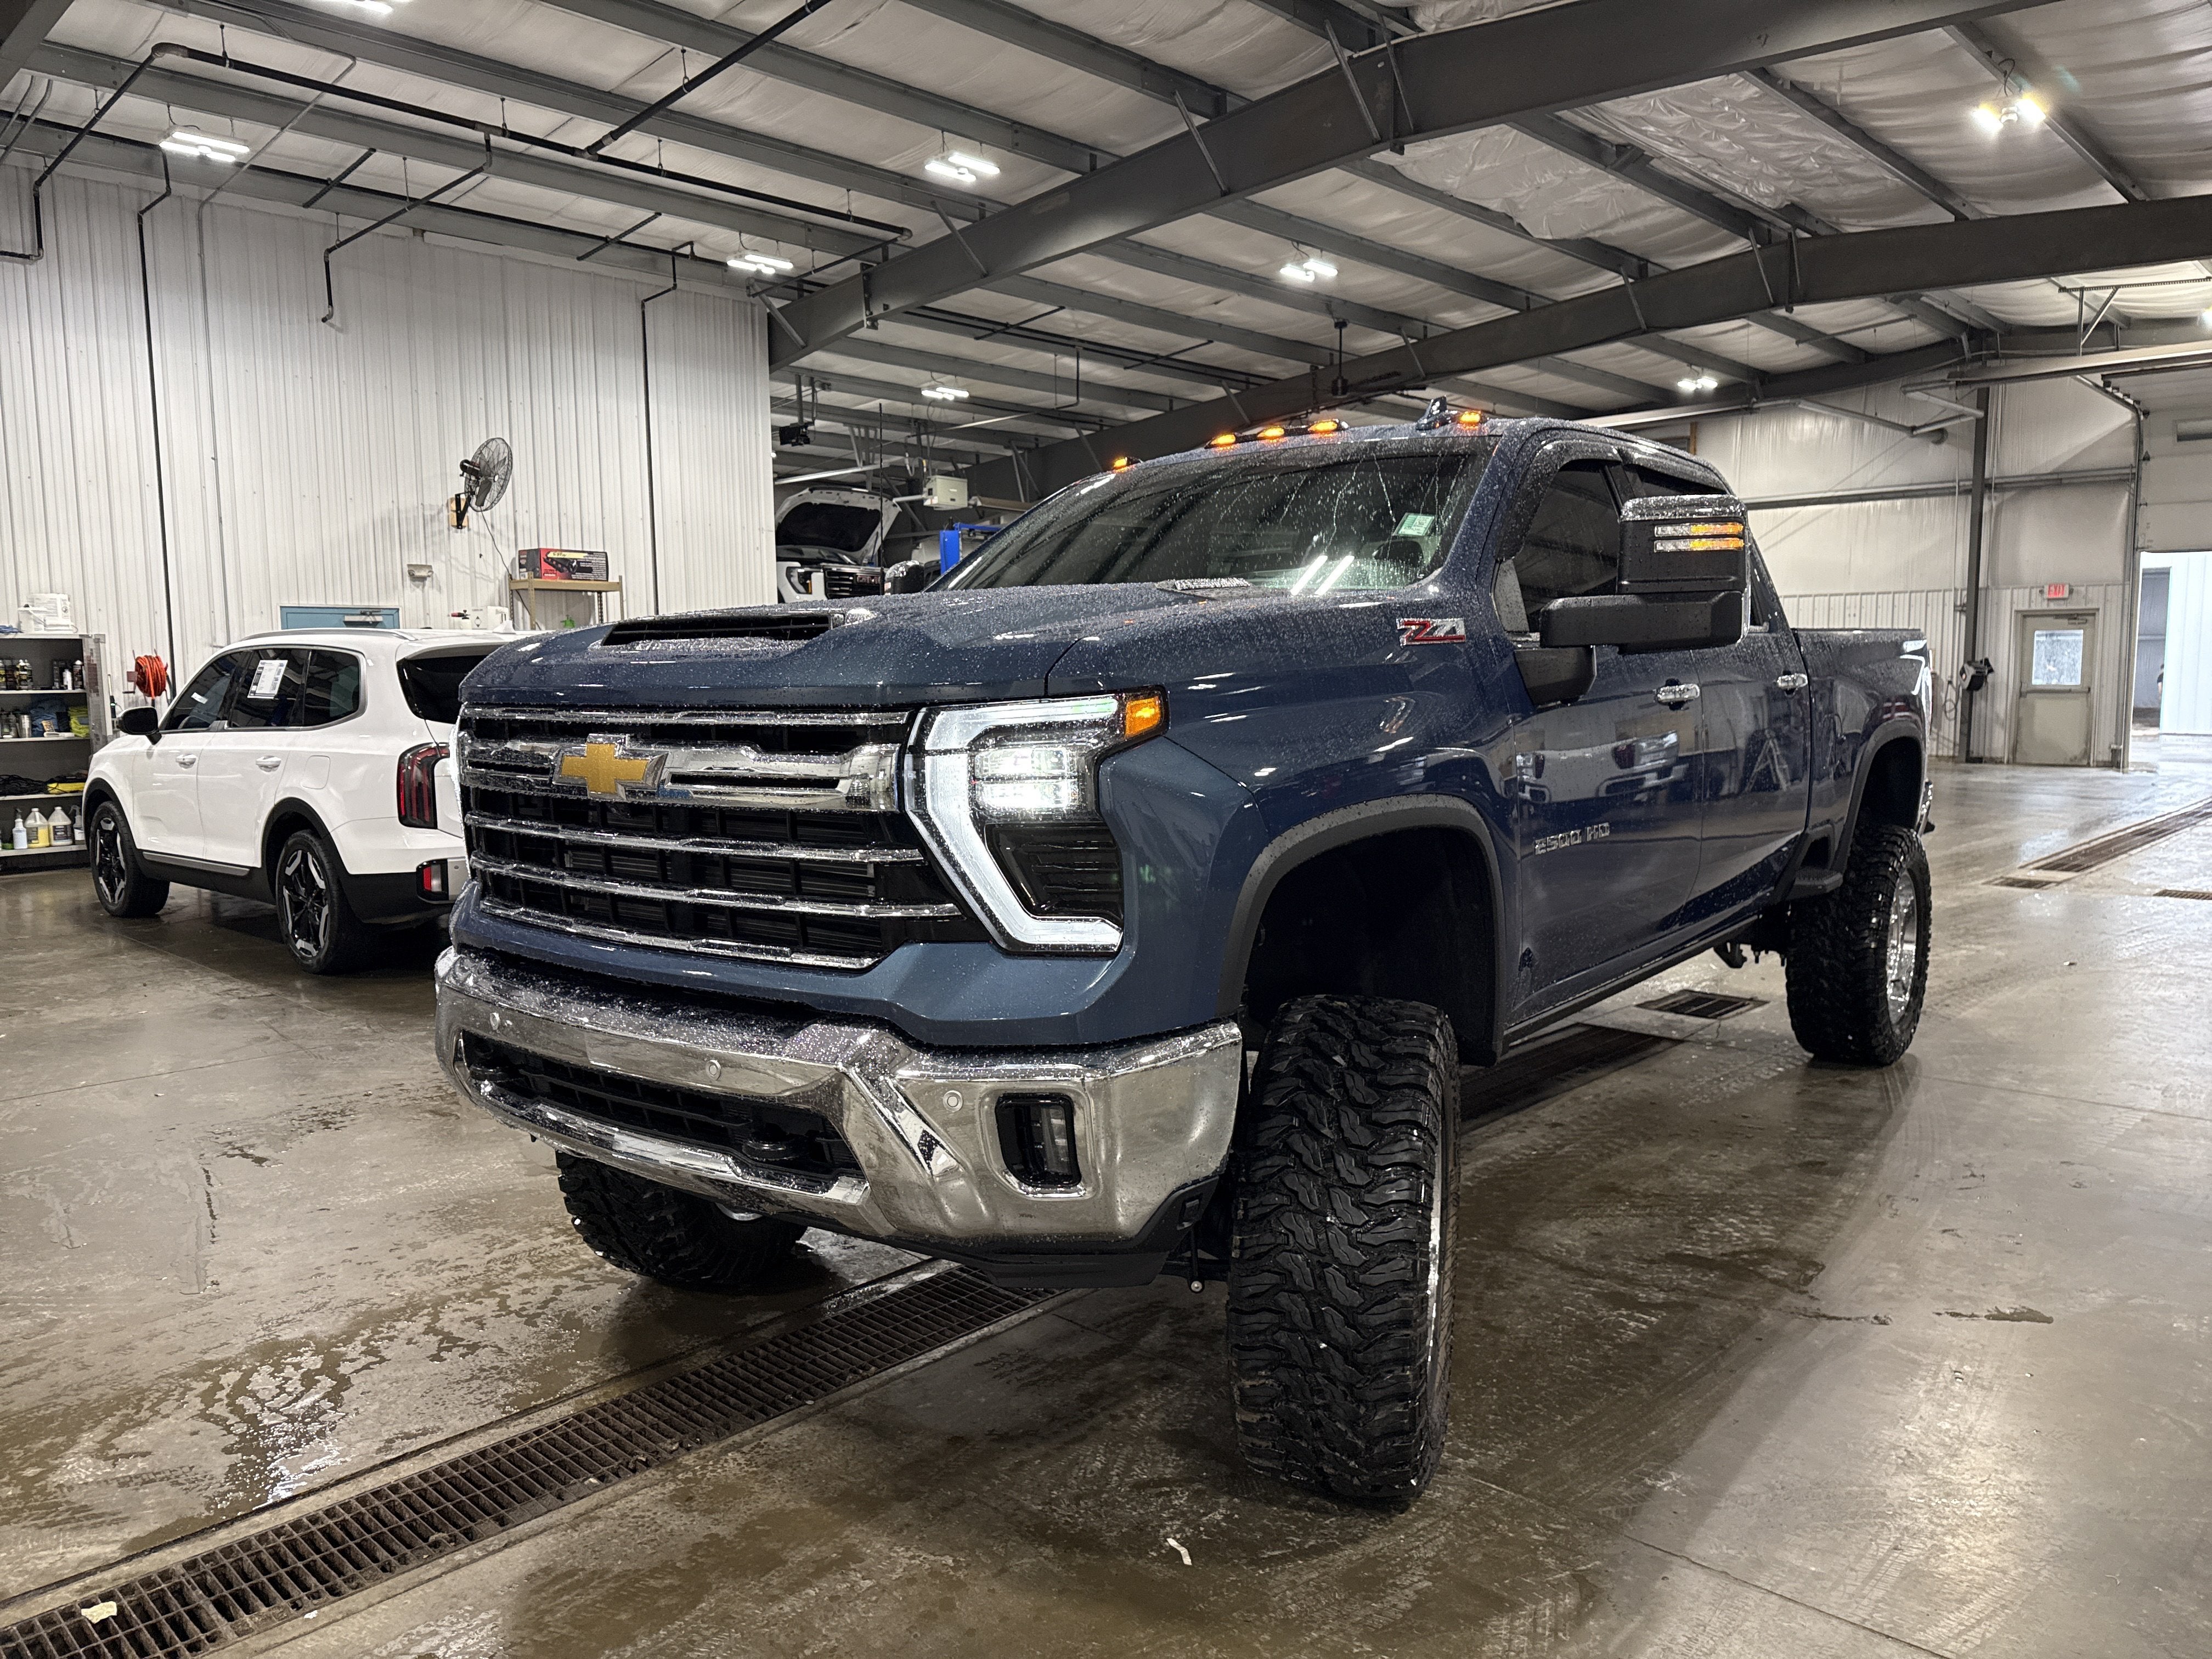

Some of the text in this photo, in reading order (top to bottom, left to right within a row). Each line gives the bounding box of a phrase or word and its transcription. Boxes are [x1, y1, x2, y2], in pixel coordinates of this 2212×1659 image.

[2048, 583, 2066, 597] EXIT
[1534, 822, 1610, 855] 2500 HD
